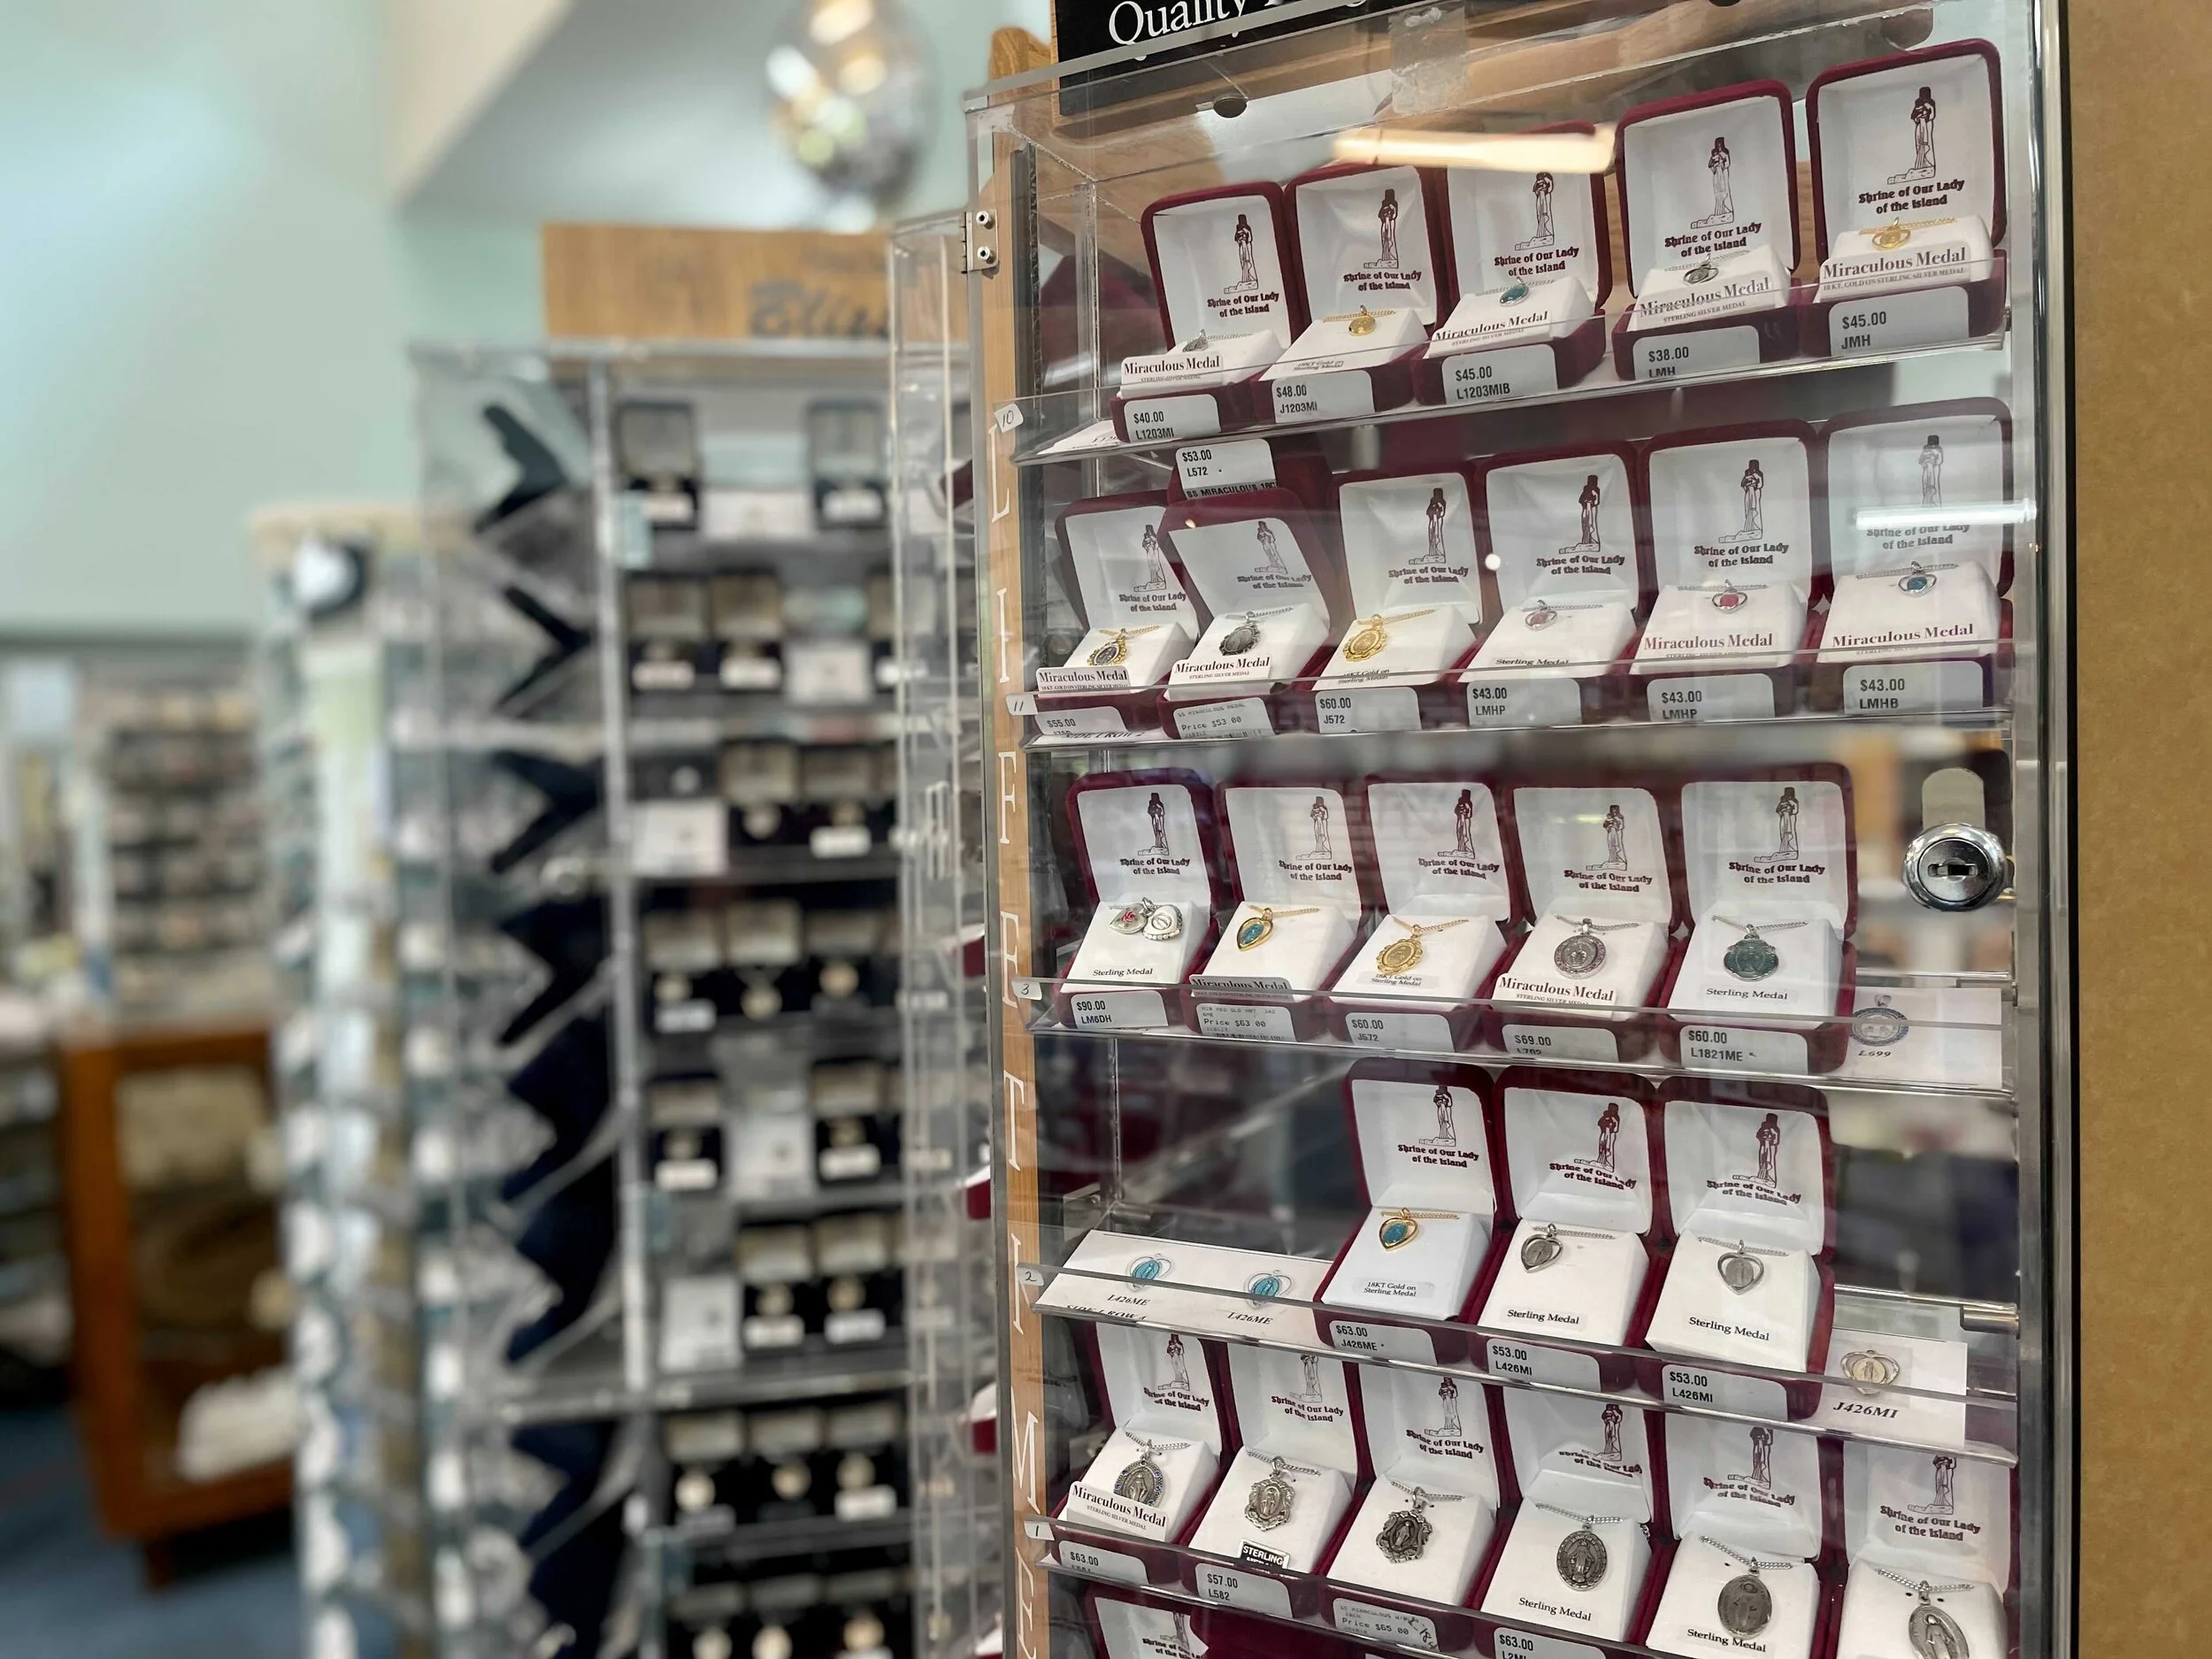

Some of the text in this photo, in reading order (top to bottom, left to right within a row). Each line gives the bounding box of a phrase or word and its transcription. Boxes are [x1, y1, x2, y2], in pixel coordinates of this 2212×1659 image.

[1858, 179, 1965, 204] Shrine of Our Lady
[1876, 195, 1947, 214] of the Island
[1664, 222, 1762, 248] Shrine of Our Lady
[1680, 237, 1747, 257] of the Island
[1494, 247, 1578, 266] Shrine of Our Lady
[1823, 247, 1966, 280] Miraculous Medal
[1509, 261, 1565, 277] of the Island
[1640, 277, 1770, 317] Miraculous Medal
[1722, 301, 1746, 311] MEDAL
[1435, 311, 1548, 342] Miraculous Medal
[1842, 311, 1886, 329] $45.00
[1841, 334, 1870, 349] JMH
[1648, 346, 1689, 363] $38.00
[1124, 356, 1220, 374] Miraculous Medal
[1648, 366, 1676, 378] LMH
[1455, 365, 1493, 381] $45.00
[1276, 385, 1307, 398] $48.00
[1456, 383, 1510, 399] L1203MIB
[1279, 403, 1317, 414] J1203MI
[1002, 411, 1014, 427] 10
[1133, 411, 1164, 424] $40.00
[1136, 427, 1174, 440] L1203MI
[1182, 449, 1212, 463] $53.00
[1187, 466, 1209, 477] L572
[1694, 542, 1789, 557] Shrine of Our Lady
[1740, 555, 1773, 565] Island
[1644, 634, 1772, 650] Miraculous Medal
[1832, 624, 1973, 648] Miraculous Medal
[1174, 657, 1270, 674] Miraculous Medal
[1039, 670, 1127, 682] Miraculous Medal
[1860, 679, 1905, 692] $43.00
[1472, 687, 1508, 700] $43.00
[1661, 690, 1702, 704] $43.00
[1319, 697, 1351, 709] $60.00
[1476, 705, 1506, 715] LMHP
[1860, 698, 1899, 709] LMHB
[1324, 715, 1346, 724] J572
[1663, 710, 1697, 719] LMHP
[1047, 718, 1076, 727] $55.00
[1729, 862, 1762, 874] Shrine
[1764, 865, 1774, 874] of
[1799, 864, 1825, 875] Lady
[1777, 874, 1810, 883] Island
[1093, 969, 1125, 978] Sterling
[1193, 979, 1288, 990] Miraculous Medal
[1499, 977, 1614, 1002] Miraculous Medal
[1706, 988, 1788, 1000] Sterling Medal
[1076, 1001, 1106, 1011] $90.00
[1081, 1015, 1112, 1025] LM6DH
[1352, 1019, 1384, 1030] $60.00
[1514, 1034, 1552, 1047] $69.00
[1688, 1030, 1727, 1044] $60.00
[1691, 1048, 1743, 1061] L1821ME
[1398, 1144, 1479, 1161] Shrine of Our Lady
[1440, 1158, 1468, 1168] Island
[1024, 1271, 1037, 1282] 2
[1363, 1287, 1391, 1296] Sterling
[1107, 1294, 1150, 1306] L426ME
[1227, 1311, 1273, 1325] L426ME
[1507, 1310, 1579, 1325] Sterling Medal
[1336, 1325, 1368, 1337] $63.00
[1689, 1317, 1770, 1341] Sterling Medal
[1341, 1340, 1378, 1351] J426ME
[1492, 1346, 1527, 1361] $53.00
[1495, 1363, 1532, 1376] L426MI
[1670, 1371, 1708, 1387] $53.00
[1672, 1387, 1713, 1402] L426MI
[1832, 1402, 1899, 1419] J426MI
[1071, 1485, 1166, 1527] Miraculous Medal
[1087, 1504, 1148, 1531] STERLING SILVER MEDAL
[1880, 1505, 1914, 1524] Shrine
[1931, 1517, 1951, 1526] Our
[1954, 1519, 1981, 1534] Lady
[1895, 1525, 1963, 1541] of the Island
[1070, 1552, 1099, 1566] $63.00
[1242, 1545, 1284, 1565] STERLING
[1207, 1573, 1238, 1589] $57.00
[1209, 1588, 1231, 1601] L582
[1518, 1597, 1592, 1621] Sterling Medal
[1342, 1617, 1370, 1628] Price
[1500, 1634, 1534, 1651] $63.00
[1686, 1629, 1766, 1653] Sterling Medal
